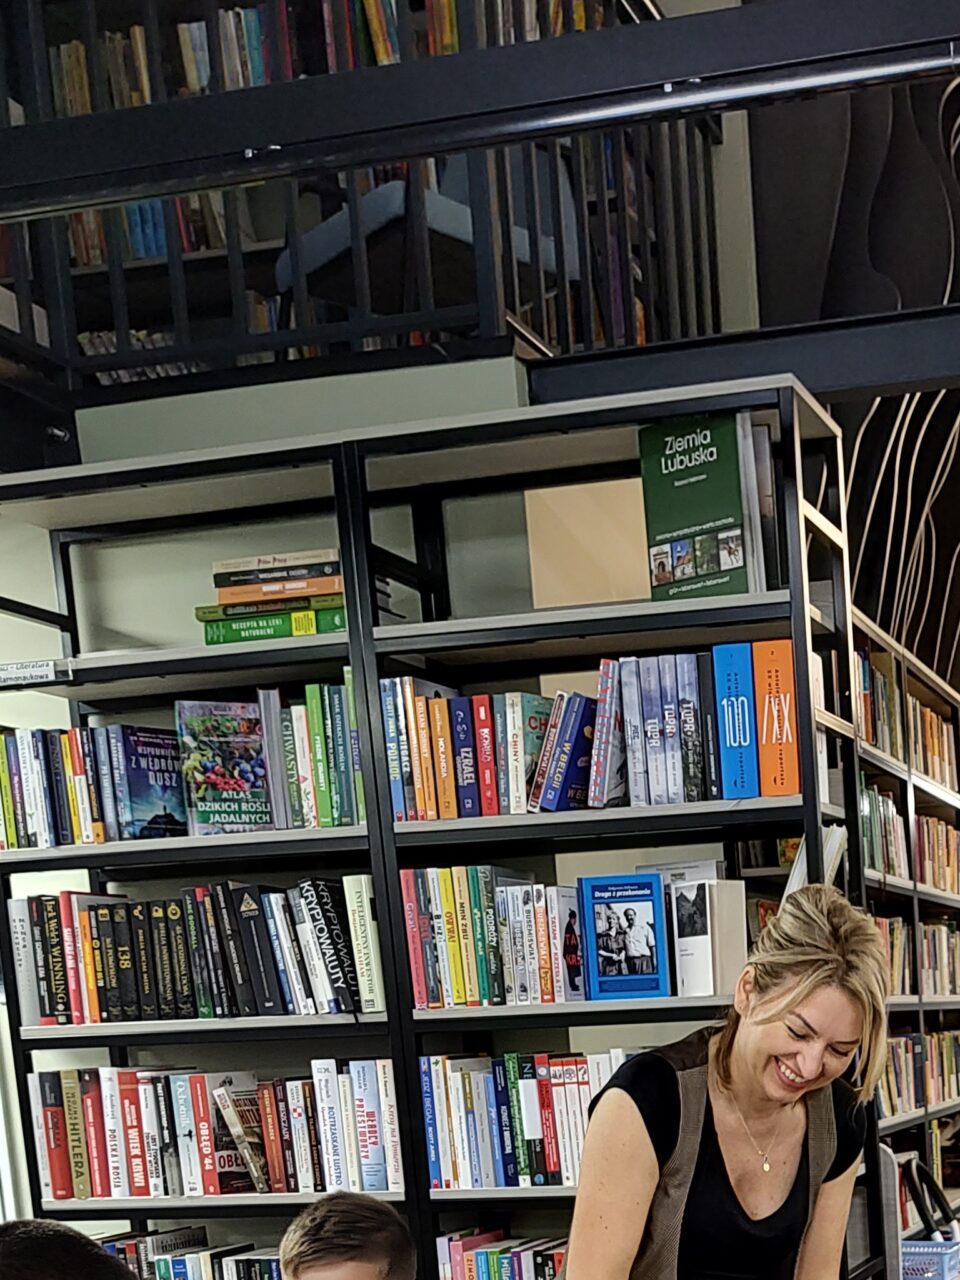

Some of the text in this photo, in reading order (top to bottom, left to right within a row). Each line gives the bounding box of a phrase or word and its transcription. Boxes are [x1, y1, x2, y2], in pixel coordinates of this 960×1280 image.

[661, 446, 717, 473] Lubuska
[665, 429, 711, 454] Ziemia
[647, 717, 661, 747] TOPR
[663, 703, 676, 733] TOPR
[680, 702, 695, 731] TOPR
[139, 756, 180, 771] WĘDRÓW
[282, 722, 298, 784] CHWASTY
[437, 738, 447, 778] HOLANDIA
[460, 747, 475, 786] IZRAEL
[551, 741, 572, 788] W BELGII
[148, 772, 179, 786] DUSZ
[198, 800, 270, 811] DZIKICH ROŚLI
[209, 814, 270, 824] JADALNYCH
[188, 915, 198, 949] GOODALL
[300, 881, 345, 988] KRYPTOWALUTY
[316, 881, 361, 1000] KRYPTOWALU
[355, 890, 374, 994] INTELIGENTNY INWESTOR
[445, 911, 456, 943] OWWA!
[486, 909, 497, 947] PODRÓŻY
[46, 901, 66, 1002] Jack Welch WINNING
[117, 945, 131, 969] 138
[159, 922, 172, 1000] BIBLIA INWESTOWANIA
[355, 943, 365, 978] GRAHAM
[175, 1081, 190, 1128] Ochotnik
[108, 1129, 119, 1158] POLSKA
[198, 1121, 214, 1170] OBŁĘD '44
[327, 1106, 342, 1186] ROZTRZASKANE LUSTRO
[355, 1098, 369, 1160] PRZESTWORZY
[367, 1111, 379, 1146] WŁADCY
[70, 1122, 85, 1179] HITLERA
[128, 1128, 145, 1187] WIEK KRWI
[112, 1166, 122, 1189] ROSJA
